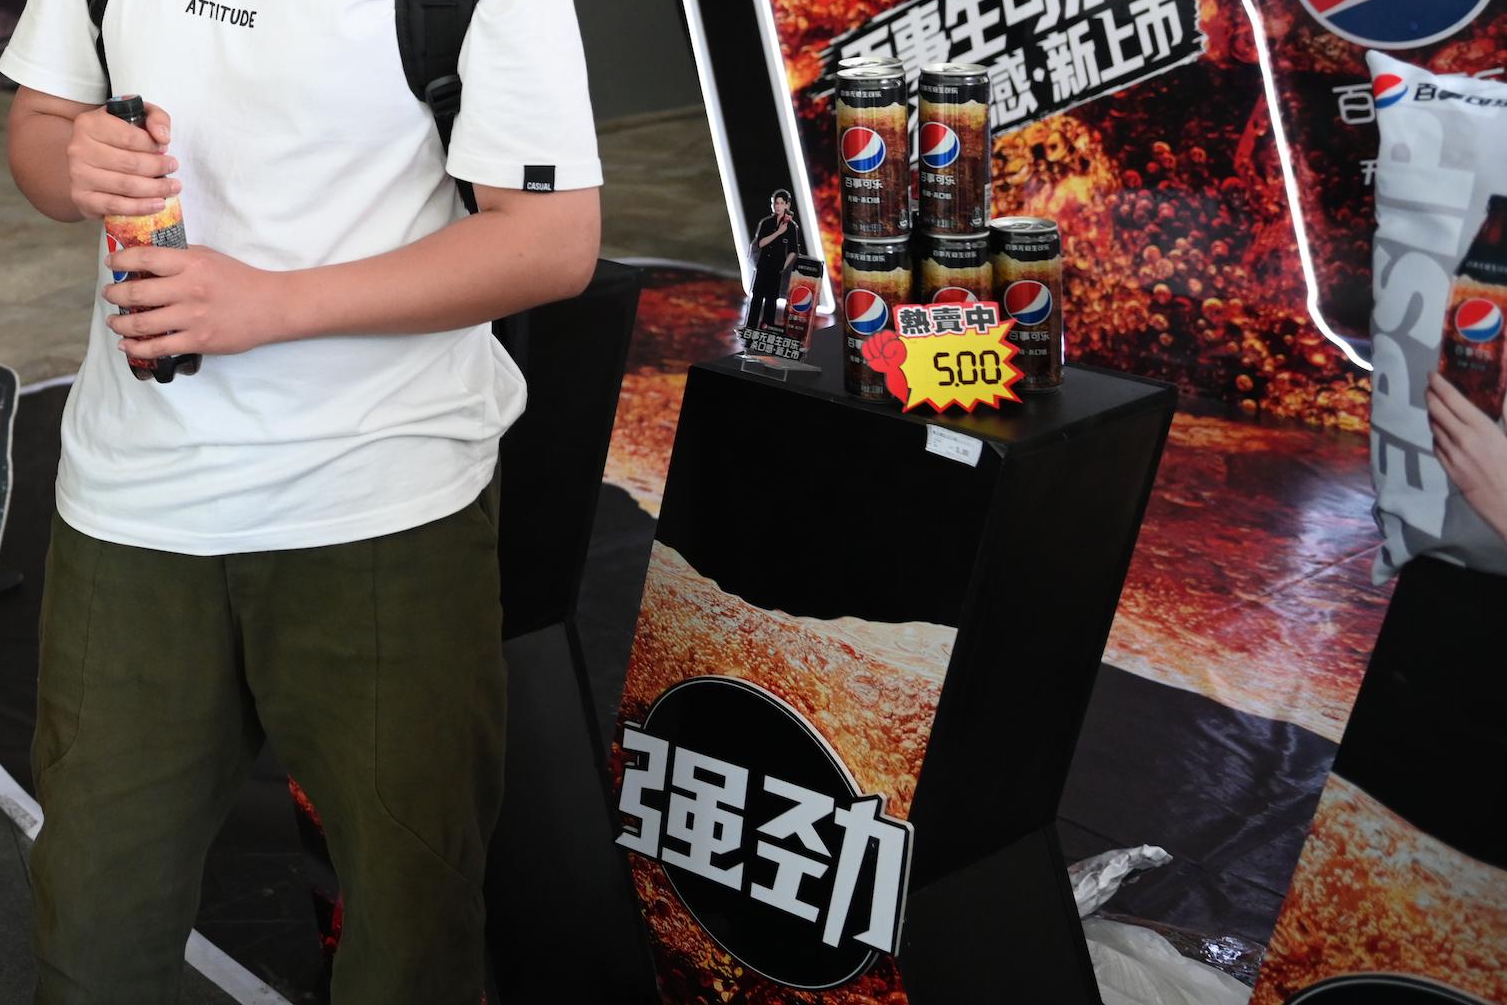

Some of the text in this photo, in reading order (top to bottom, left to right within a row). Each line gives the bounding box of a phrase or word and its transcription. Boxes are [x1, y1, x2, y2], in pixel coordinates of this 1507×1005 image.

[527, 182, 552, 191] CASUAL
[845, 178, 883, 189] 百事可乐
[898, 304, 998, 335] 熱賣中
[932, 350, 1003, 387] 5.00
[615, 728, 906, 953] 强劲
